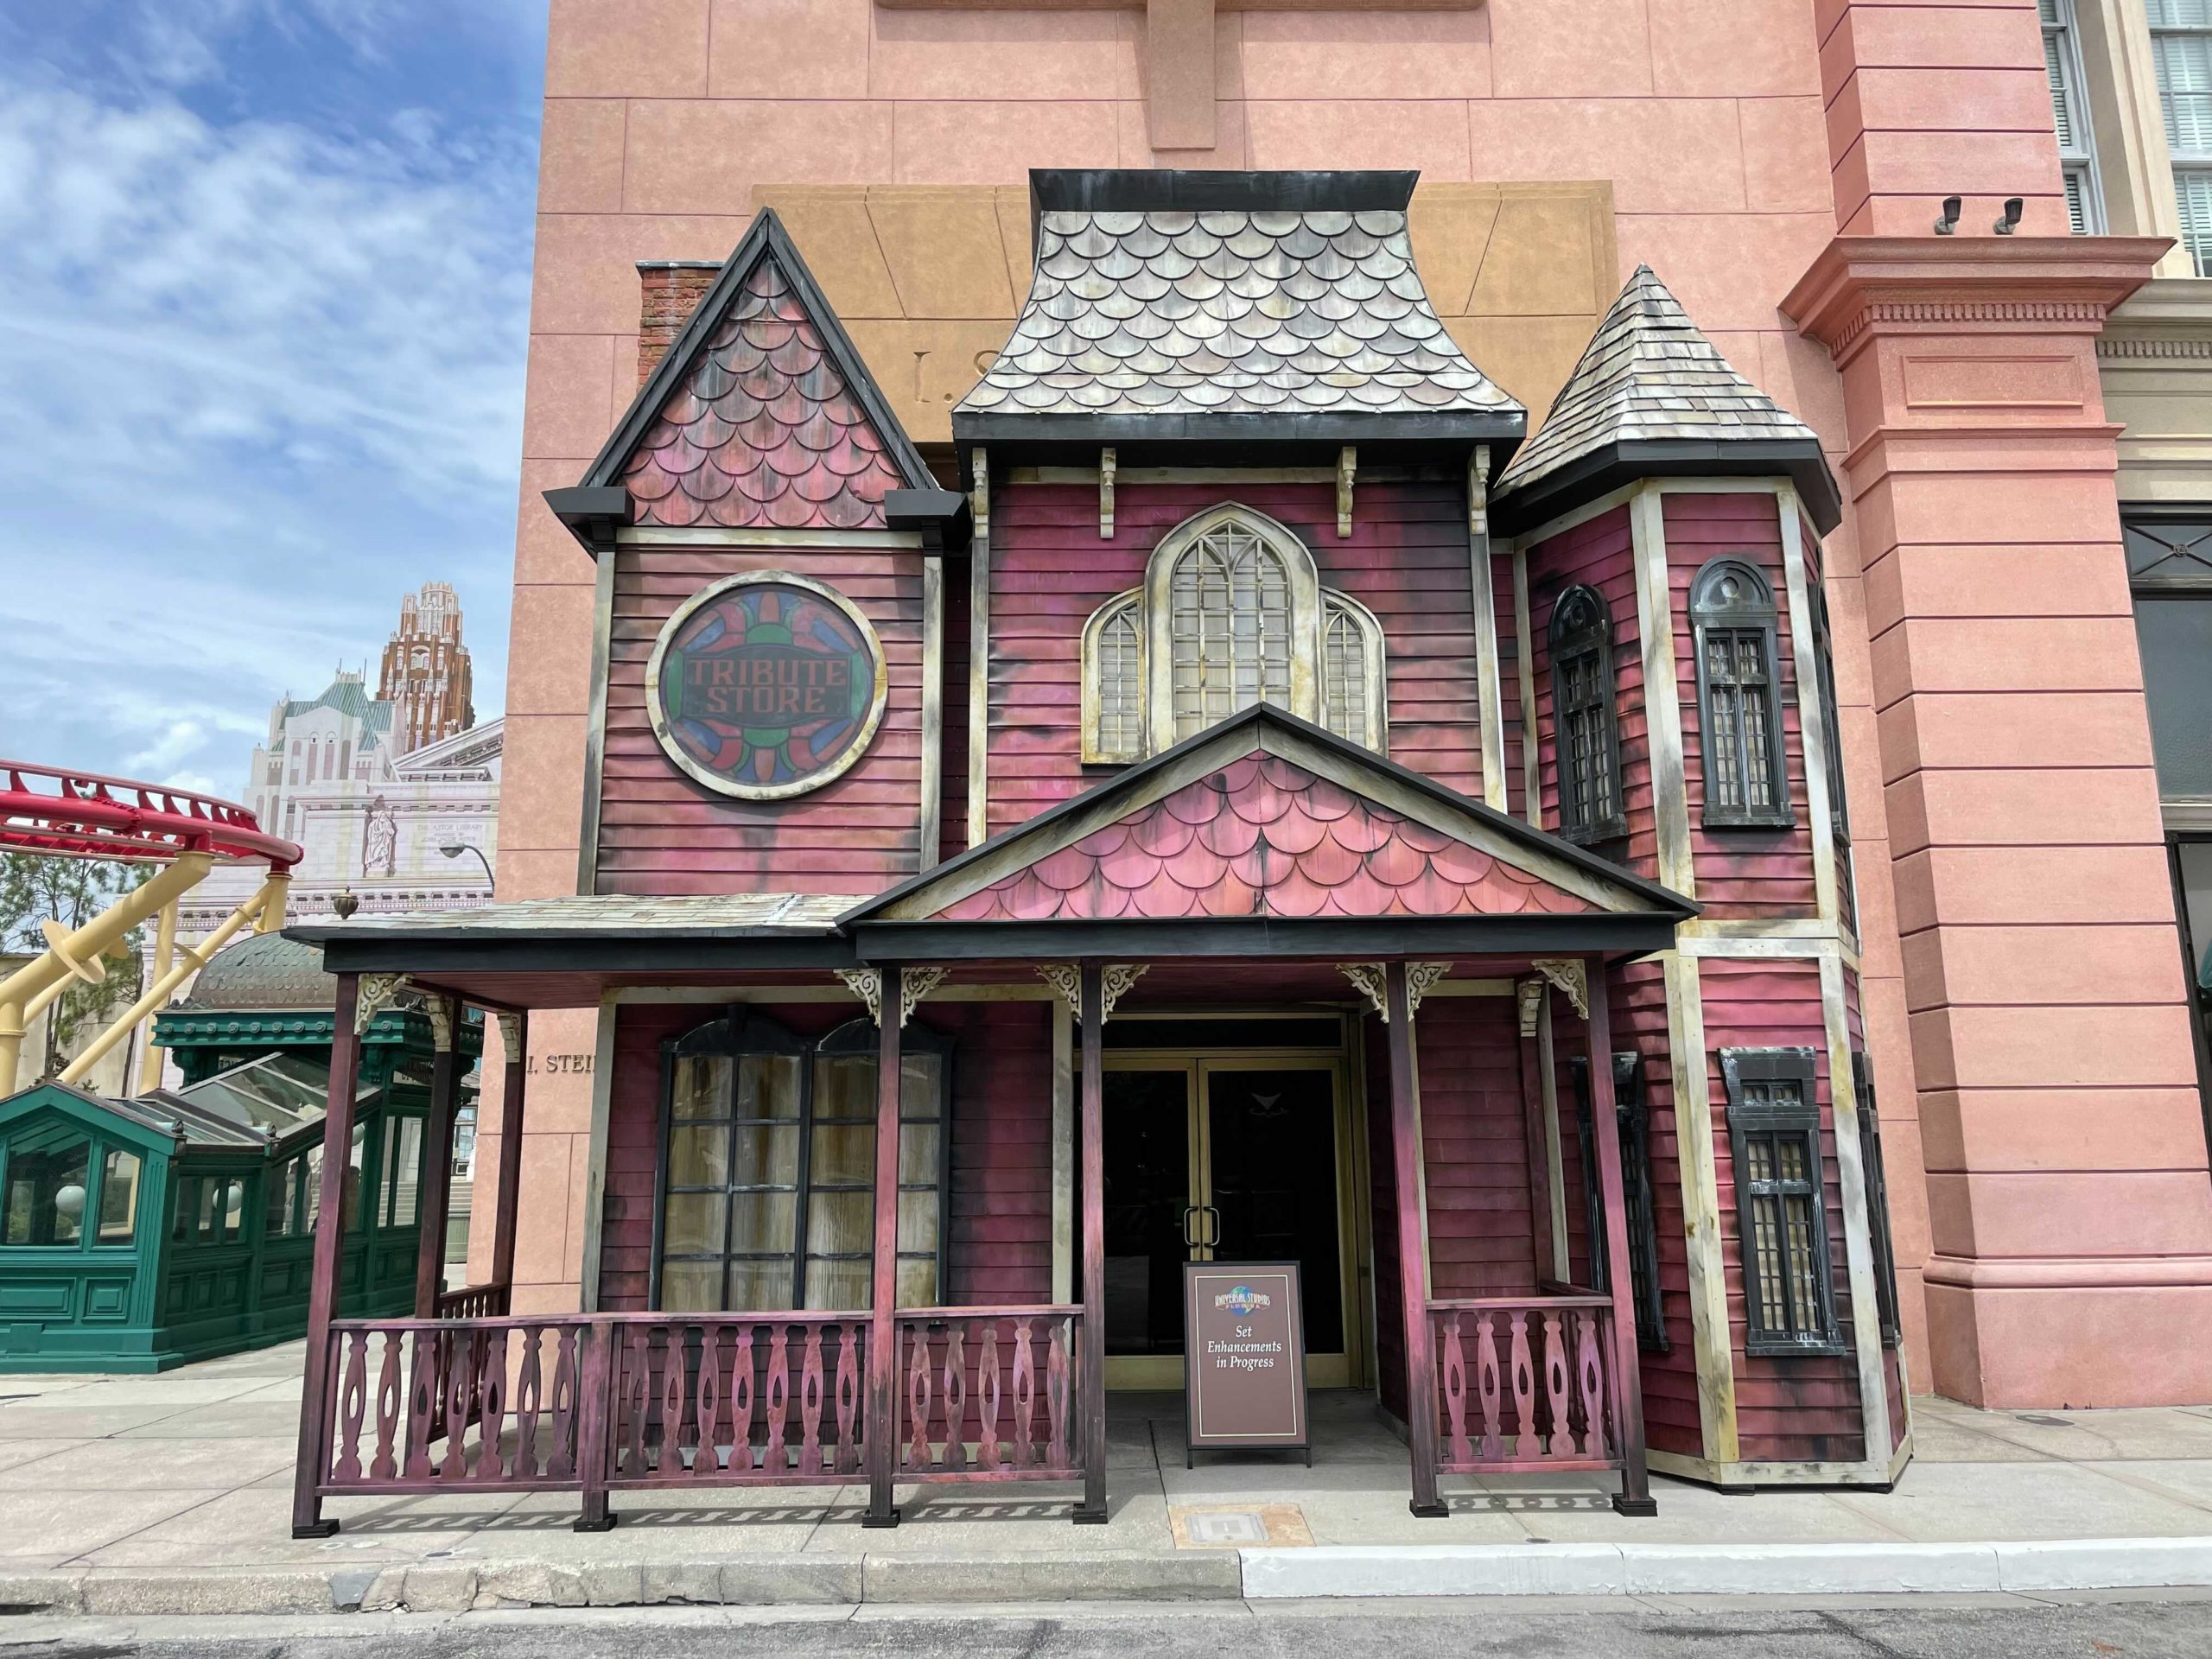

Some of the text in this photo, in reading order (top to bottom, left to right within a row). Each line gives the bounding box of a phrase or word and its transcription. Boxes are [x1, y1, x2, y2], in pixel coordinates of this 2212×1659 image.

[689, 659, 846, 685] TRIBUTE
[706, 687, 825, 714] STORE
[546, 1054, 596, 1073] STEI
[1215, 1293, 1270, 1306] UNIVERSAL STUDIOS
[1236, 1325, 1252, 1338] Set
[1207, 1340, 1282, 1353] Enhancements
[1216, 1355, 1274, 1371] in Progress
